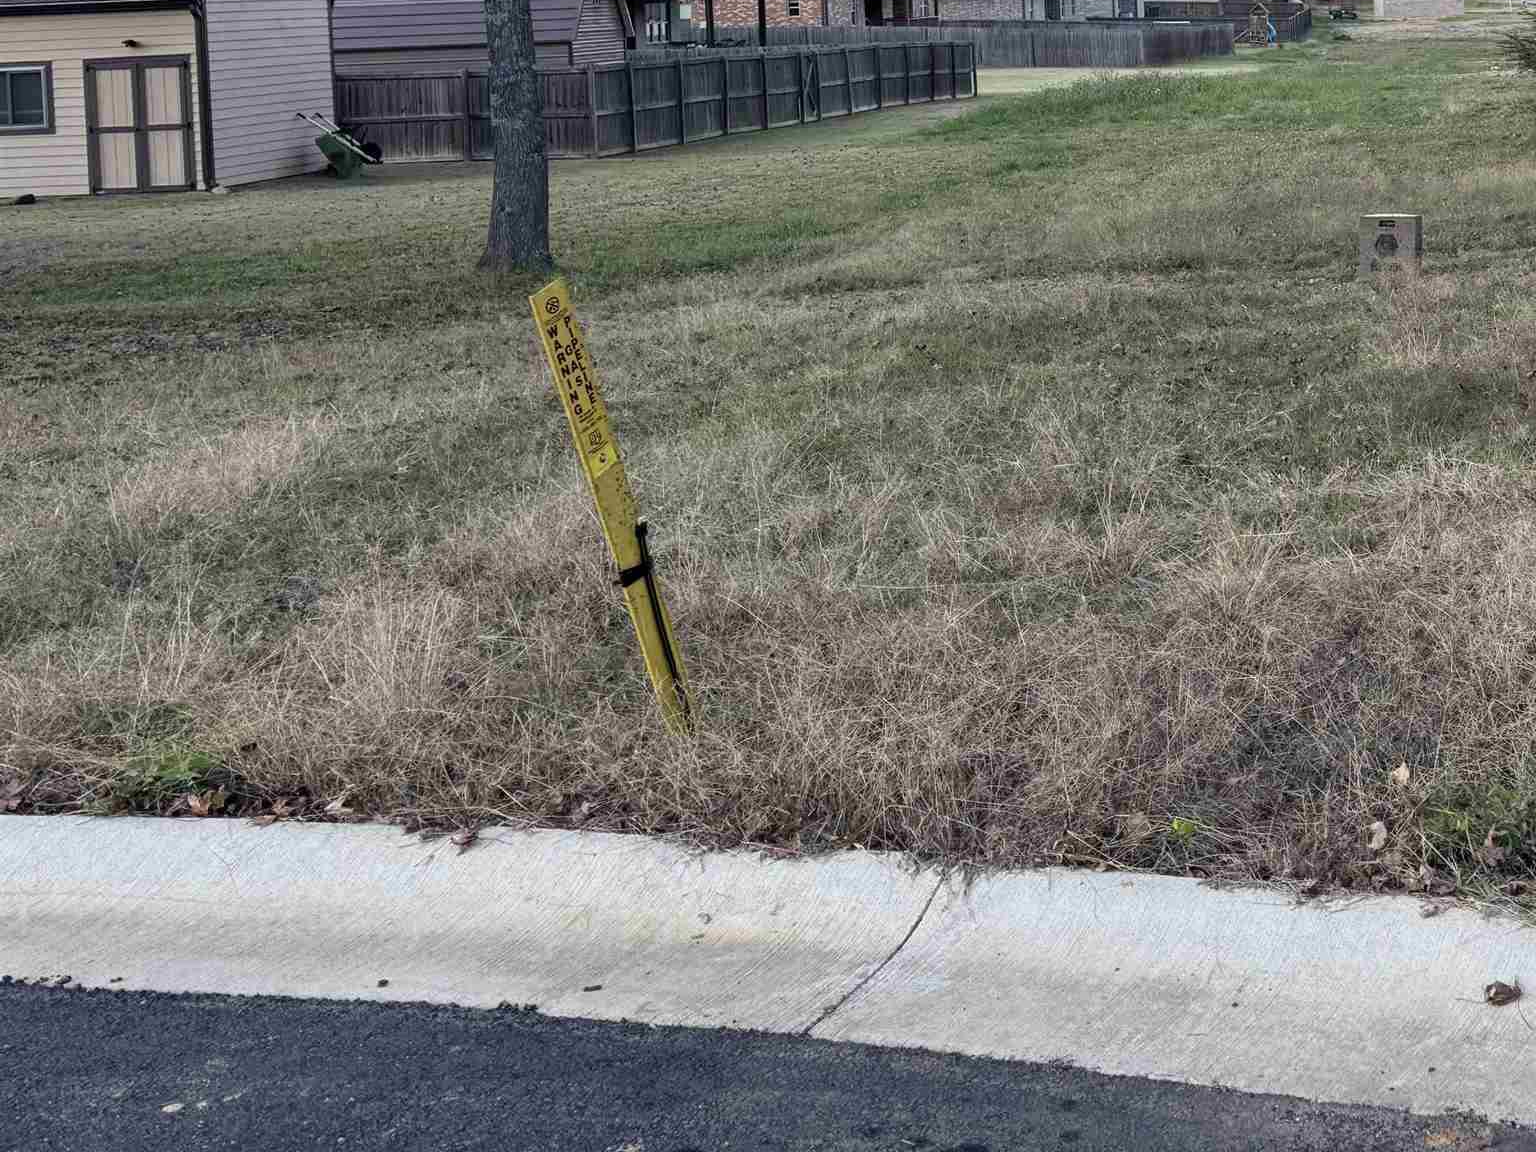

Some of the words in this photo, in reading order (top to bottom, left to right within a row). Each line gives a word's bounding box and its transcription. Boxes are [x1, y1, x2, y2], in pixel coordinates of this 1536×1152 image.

[547, 324, 583, 415] WARNING
[563, 315, 597, 405] PIPELINE
[564, 345, 583, 386] GAS
